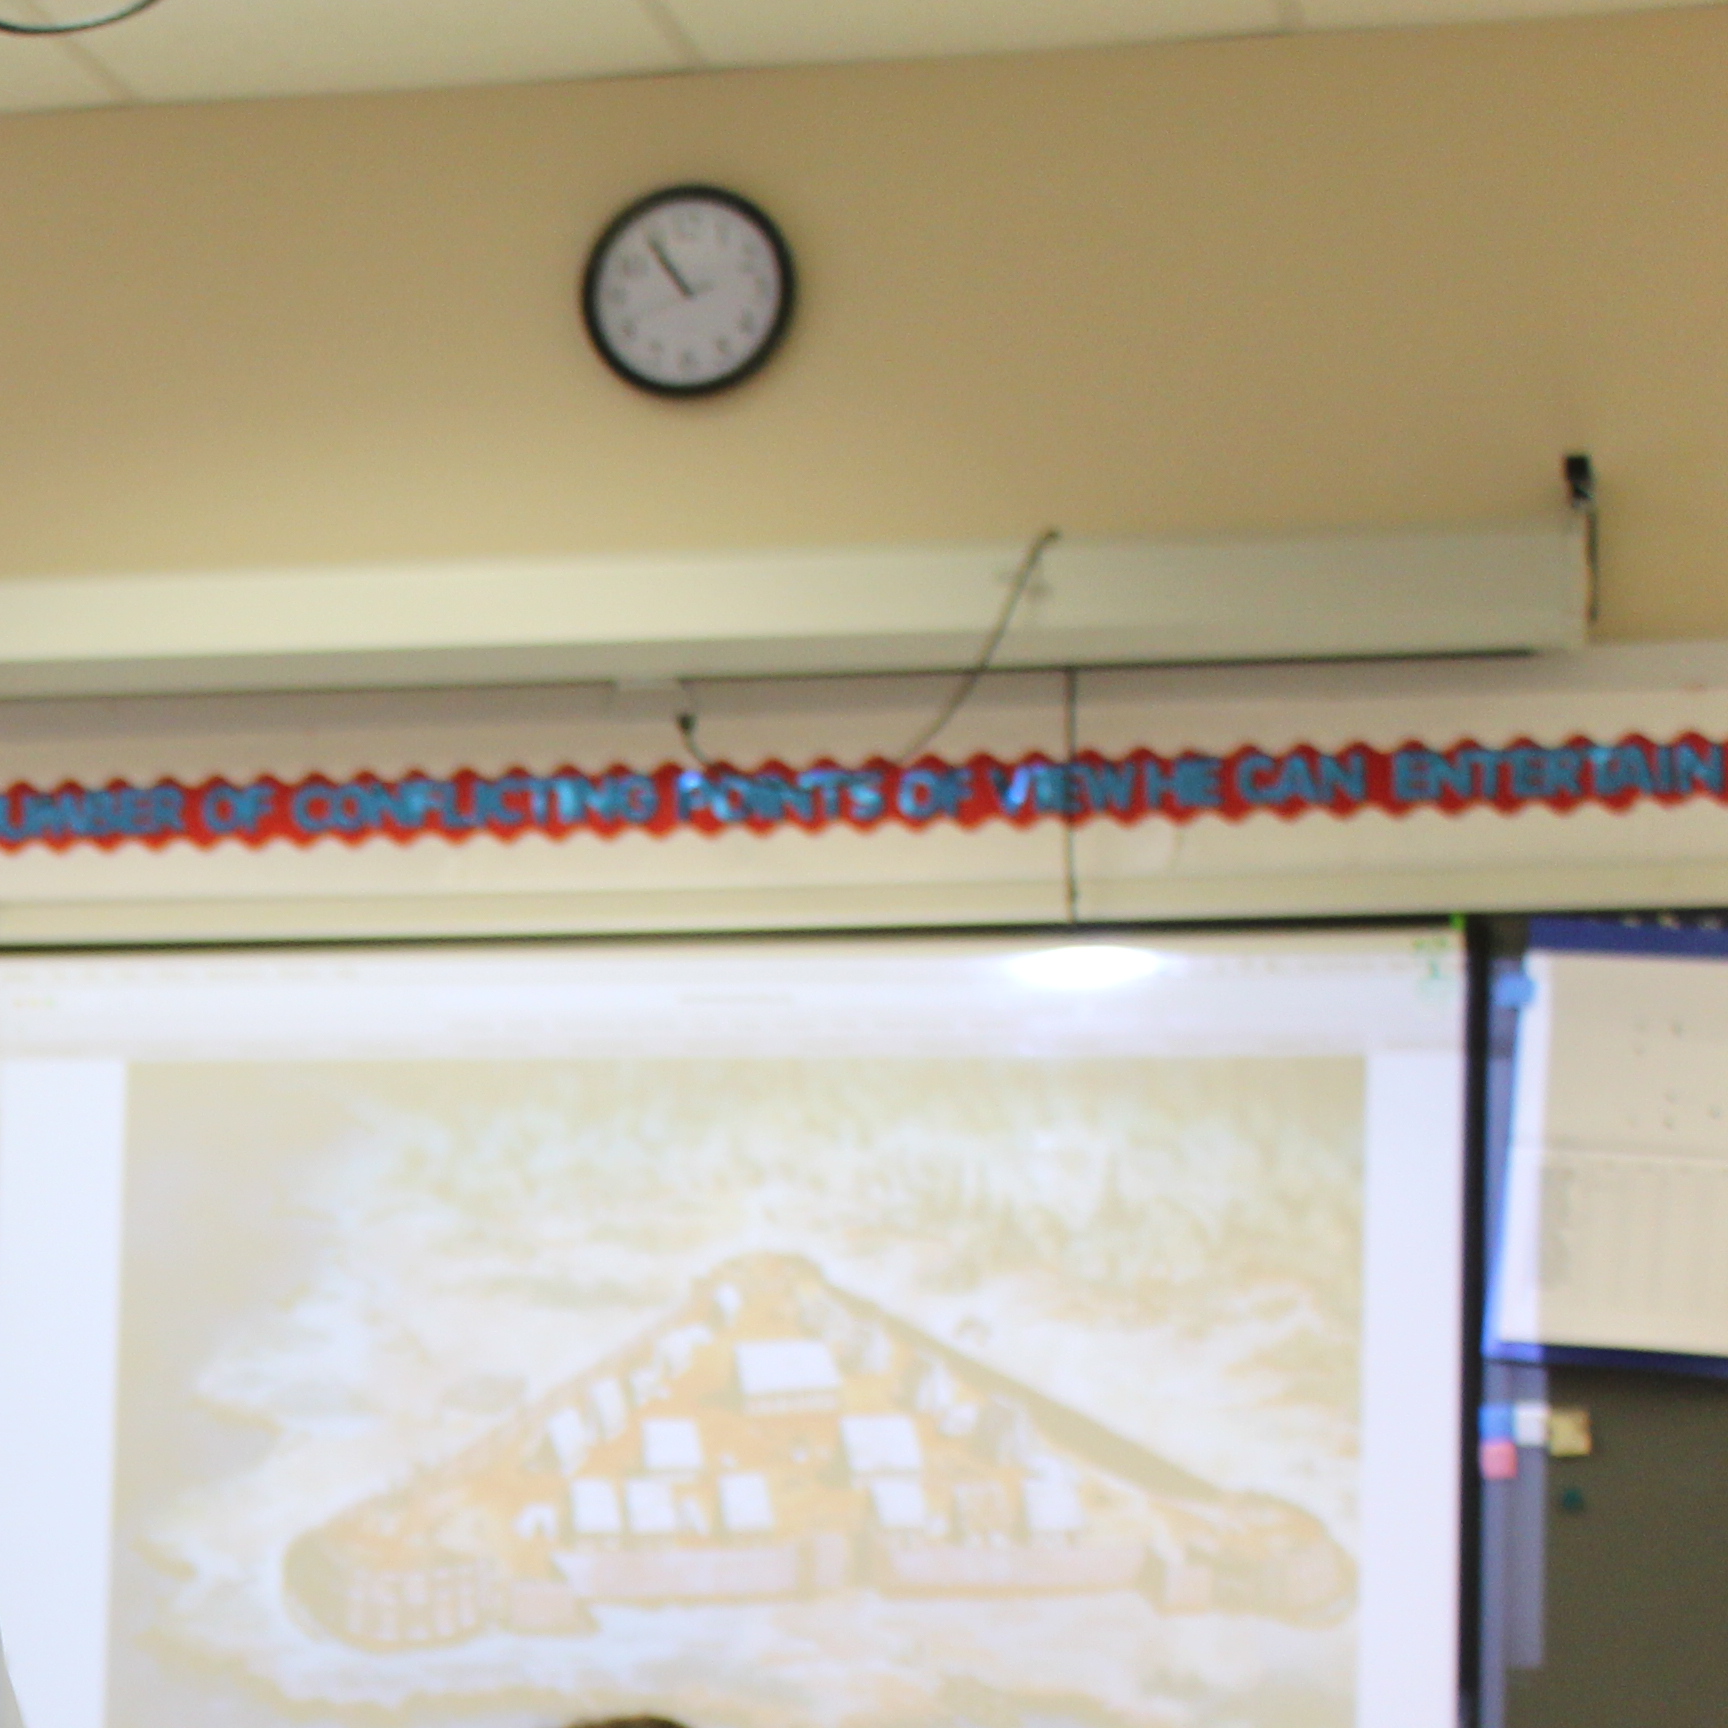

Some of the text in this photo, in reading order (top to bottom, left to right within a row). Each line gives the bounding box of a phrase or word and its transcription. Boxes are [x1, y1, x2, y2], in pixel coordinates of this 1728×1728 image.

[204, 784, 274, 833] OF
[291, 774, 657, 833] CONFLICTING
[677, 766, 885, 822] POINTS
[897, 766, 973, 820] OF
[990, 758, 1137, 815] VIEW
[1145, 755, 1224, 808] HE
[1236, 753, 1367, 804] CAN
[1394, 743, 1724, 799] ENTERTAIN
